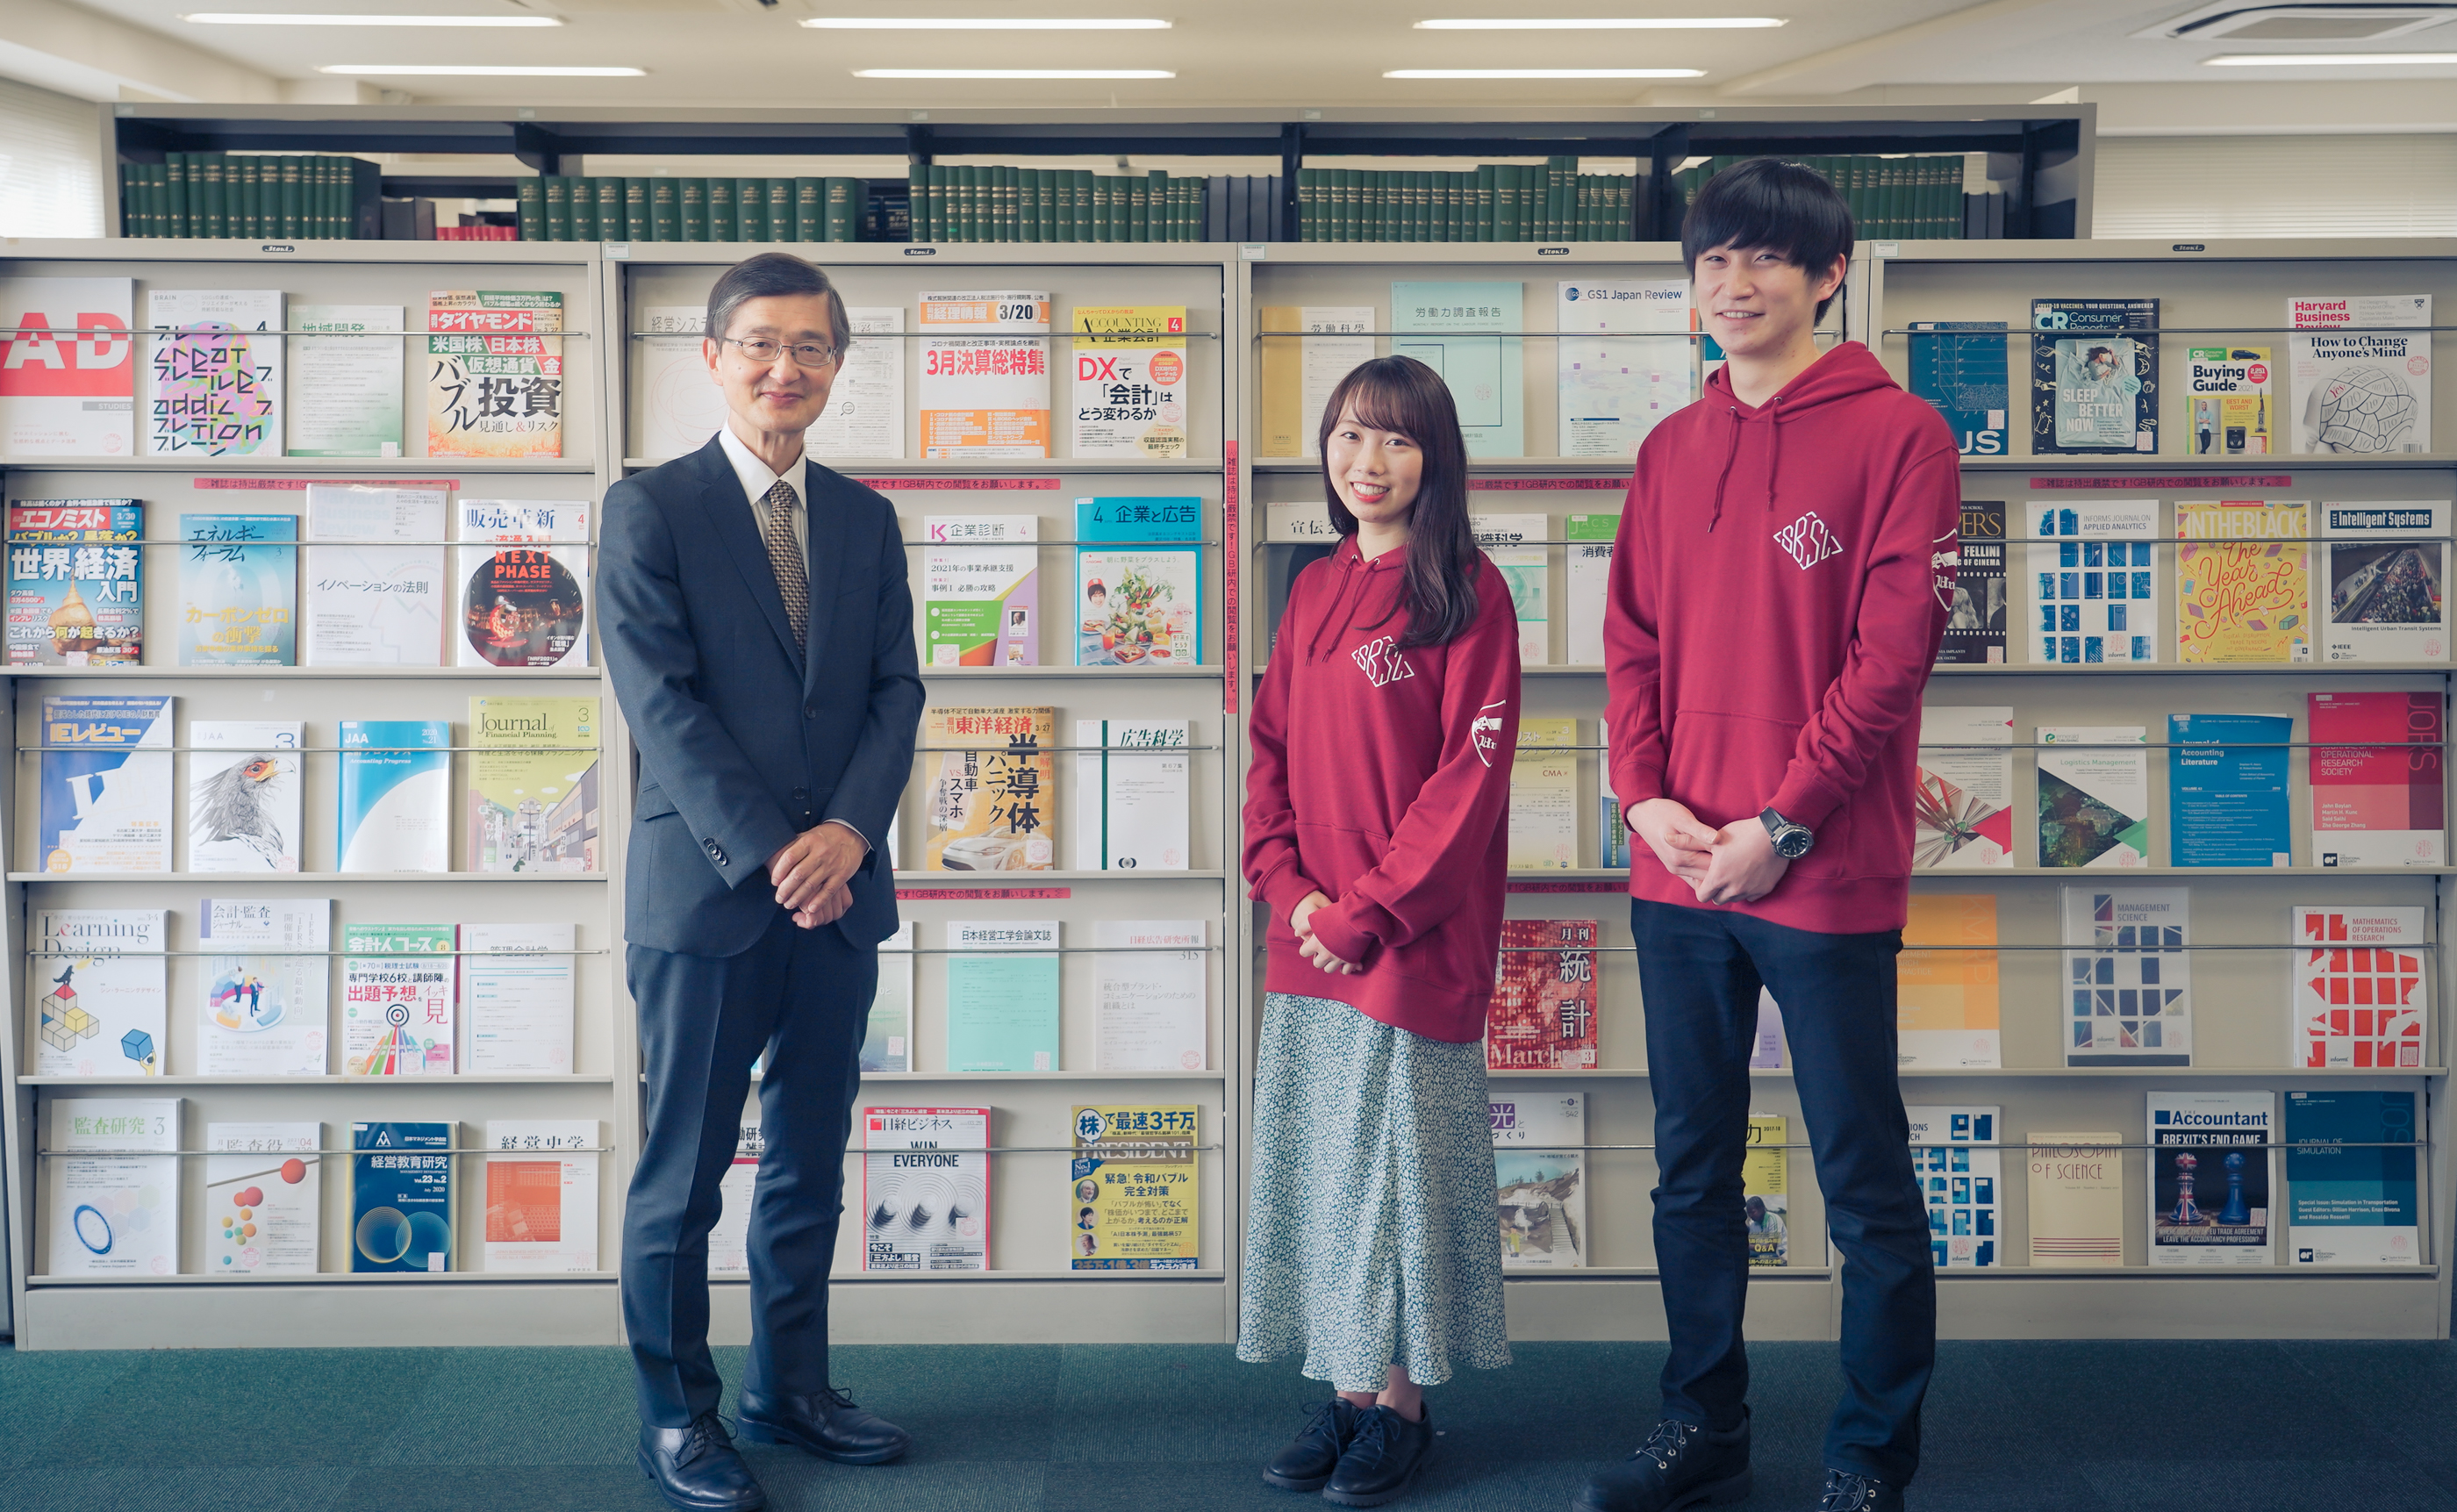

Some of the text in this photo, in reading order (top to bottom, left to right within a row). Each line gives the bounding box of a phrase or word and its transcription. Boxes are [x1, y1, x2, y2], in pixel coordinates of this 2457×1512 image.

[1587, 289, 1682, 301] GS1 Japan Review
[935, 306, 987, 319] 経理情報
[999, 305, 1033, 319] 3/20
[1415, 307, 1501, 318] 労働力調査報告
[2295, 300, 2346, 311] Harvard
[439, 312, 533, 330] ダイヤモンド
[2035, 312, 2068, 330] CR
[2069, 312, 2122, 323] Consumer
[2296, 312, 2350, 322] Business
[4, 313, 129, 369] AD
[433, 336, 483, 352] 米国株
[491, 337, 540, 353] 日本株
[2310, 336, 2408, 348] How to Change
[927, 348, 1044, 376] 3月決算総特集
[2312, 347, 2406, 361] Anyone's Mind
[468, 356, 535, 374] 仮想通貨
[543, 357, 561, 374] 金
[2194, 364, 2245, 380] Buying
[2193, 378, 2237, 391] Guide
[478, 376, 561, 418] 投資
[1103, 383, 1173, 405] 「会計」は
[2063, 389, 2097, 402] SLEEP
[1079, 407, 1157, 420] どう変わるか
[2079, 404, 2124, 417] BETTER
[2067, 419, 2094, 432] NOW
[18, 509, 105, 528] エコノミスト
[466, 508, 555, 529] 販売革新
[1115, 505, 1196, 523] 企業と広告
[2339, 511, 2430, 527] Intelligent Systems
[950, 524, 1004, 536] 企業診断
[2186, 511, 2301, 538] INTHEBLACK
[188, 525, 264, 541] エネルギー
[189, 545, 245, 563] フォーラム
[495, 550, 551, 563] NEXT
[1964, 546, 2000, 557] FELLINI
[11, 547, 138, 581] 世界経済
[495, 565, 551, 578] PHASE
[97, 581, 137, 602] 入門
[317, 578, 428, 594] イノベーションの法則
[186, 607, 288, 623] カーボンゼロ
[9, 626, 139, 639] これから何が起きるか?
[212, 627, 261, 644] の衝撃
[477, 713, 548, 735] Journal
[956, 716, 1033, 735] 東洋経済
[2408, 694, 2436, 770] JORS
[50, 723, 140, 742] IEレビュー
[345, 734, 369, 743] JAA
[1121, 729, 1184, 753] 広告科学
[2181, 749, 2224, 758] Accounting
[964, 750, 978, 792] 自動車
[985, 751, 1006, 825] パニック
[1006, 734, 1040, 834] 半導体
[939, 779, 948, 832] 争奪戦の深層
[950, 778, 963, 819] スマホ
[213, 906, 271, 919] 会計・監査
[42, 916, 150, 944] Learning
[212, 920, 243, 929] ジャーナル
[962, 929, 1052, 941] 日本経営工学会論文誌
[1129, 935, 1200, 944] 日経広告研究所報
[1561, 928, 1590, 941] 月刊
[42, 938, 121, 967] Design
[349, 973, 449, 984] 専門学校6校と講師陣の
[1103, 992, 1196, 1000] コミュニケーションのための
[1559, 944, 1593, 1039] 統計
[1103, 1001, 1135, 1010] 組織とは
[1490, 1043, 1563, 1064] March
[75, 1116, 145, 1135] 監査研究
[884, 1117, 952, 1130] 日経ビジネス
[2173, 1111, 2268, 1125] Accountant
[2163, 1134, 2260, 1144] BREXIT'S END GAME
[1081, 1142, 1192, 1159] PRESIDENT
[371, 1156, 448, 1169] 経営教育研究
[894, 1155, 959, 1167] EVERYONE
[1134, 1173, 1188, 1184] 令和バブル
[2057, 1164, 2102, 1179] SCIENCE
[1124, 1186, 1170, 1197] 完全対策
[1754, 1243, 1775, 1252] Q&A
